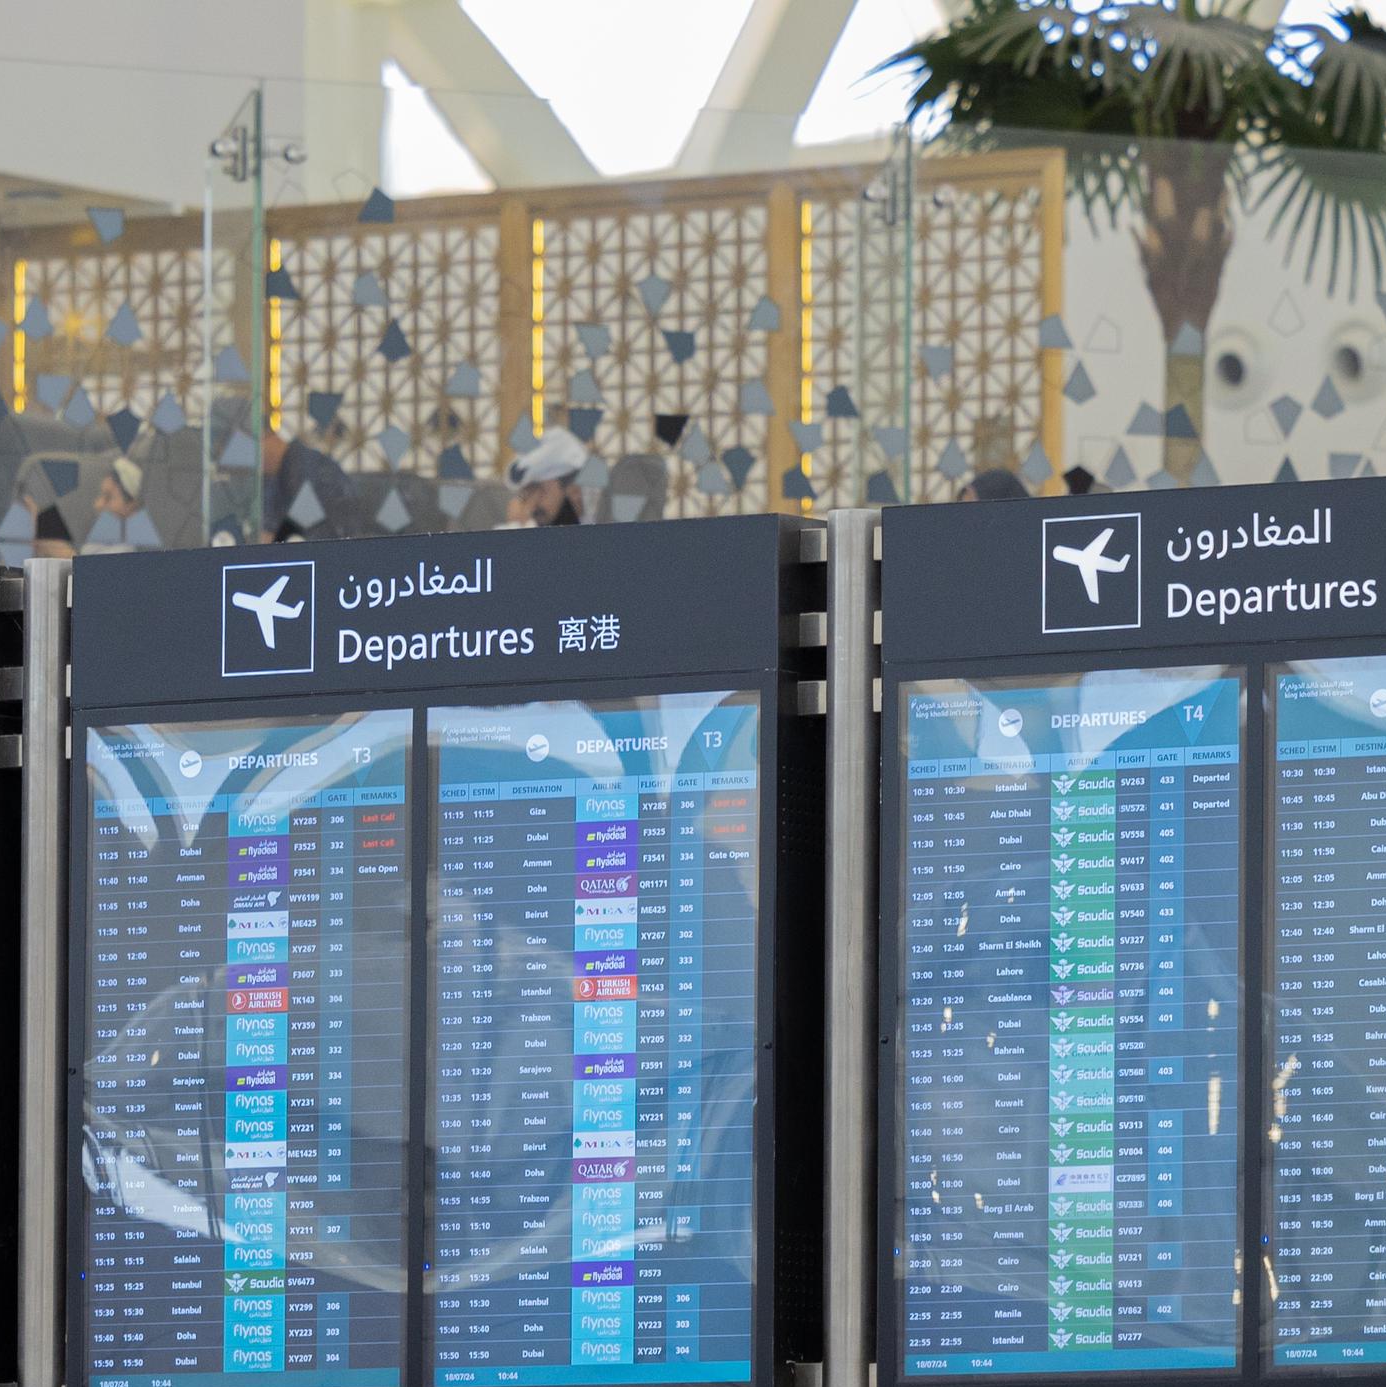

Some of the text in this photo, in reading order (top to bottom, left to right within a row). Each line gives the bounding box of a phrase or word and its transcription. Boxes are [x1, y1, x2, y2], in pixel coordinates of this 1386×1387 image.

[1167, 508, 1331, 561] المغادرون
[339, 558, 491, 609] المغادرون
[1168, 578, 1377, 624] Departures
[339, 614, 620, 670] Departures 离港
[1049, 705, 1204, 731] DEPARTURES T4
[577, 731, 722, 756] DEPARTURES T3
[229, 747, 370, 771] DEPARTURES T3
[911, 766, 936, 774] SCHED
[943, 764, 966, 772] ESTIM
[982, 758, 1038, 771] DESTINATION
[1068, 755, 1101, 765] AIRLINE
[1119, 755, 1144, 763] FLIGHT
[1193, 751, 1231, 759] REMARKS
[913, 773, 1230, 796] 10:30 10:30 Istanbul Saudia SV263 433 Departed
[99, 877, 118, 885] 11:40
[128, 876, 147, 884] 11:40
[176, 874, 205, 882] Amman
[247, 871, 278, 883] flyadeal
[294, 868, 315, 876] F3541
[330, 867, 343, 875] 334
[378, 865, 398, 874] Open
[443, 991, 462, 999] 12:15
[472, 989, 492, 998] 12:15
[522, 987, 551, 996] Istanbul
[597, 979, 630, 987] TURKISH
[679, 983, 692, 991] 304
[597, 986, 630, 996] AIRLINES
[1279, 1301, 1300, 1309] 22:55
[1311, 1300, 1332, 1308] 22:55
